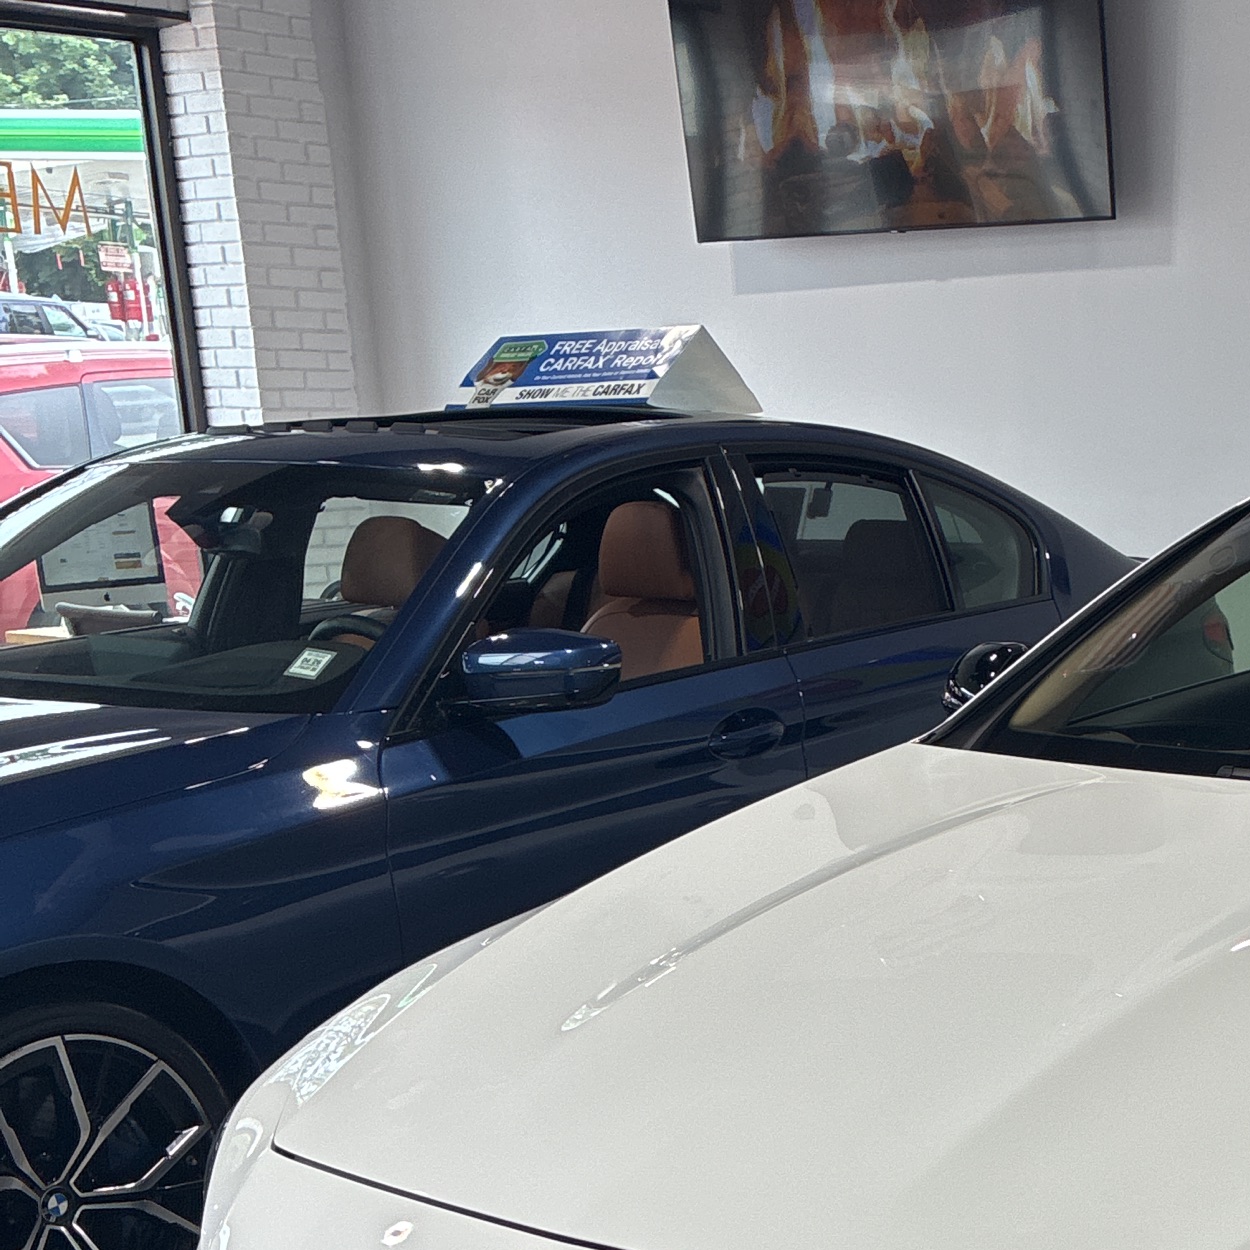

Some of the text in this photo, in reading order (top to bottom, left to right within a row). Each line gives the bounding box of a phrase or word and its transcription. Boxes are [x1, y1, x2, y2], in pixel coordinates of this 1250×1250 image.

[550, 340, 597, 355] FREE
[539, 356, 608, 372] CARFAX
[477, 388, 498, 396] CAR
[515, 387, 555, 400] SHOW
[552, 386, 574, 398] ME
[592, 383, 646, 397] CARFAX
[472, 396, 491, 404] FOX
